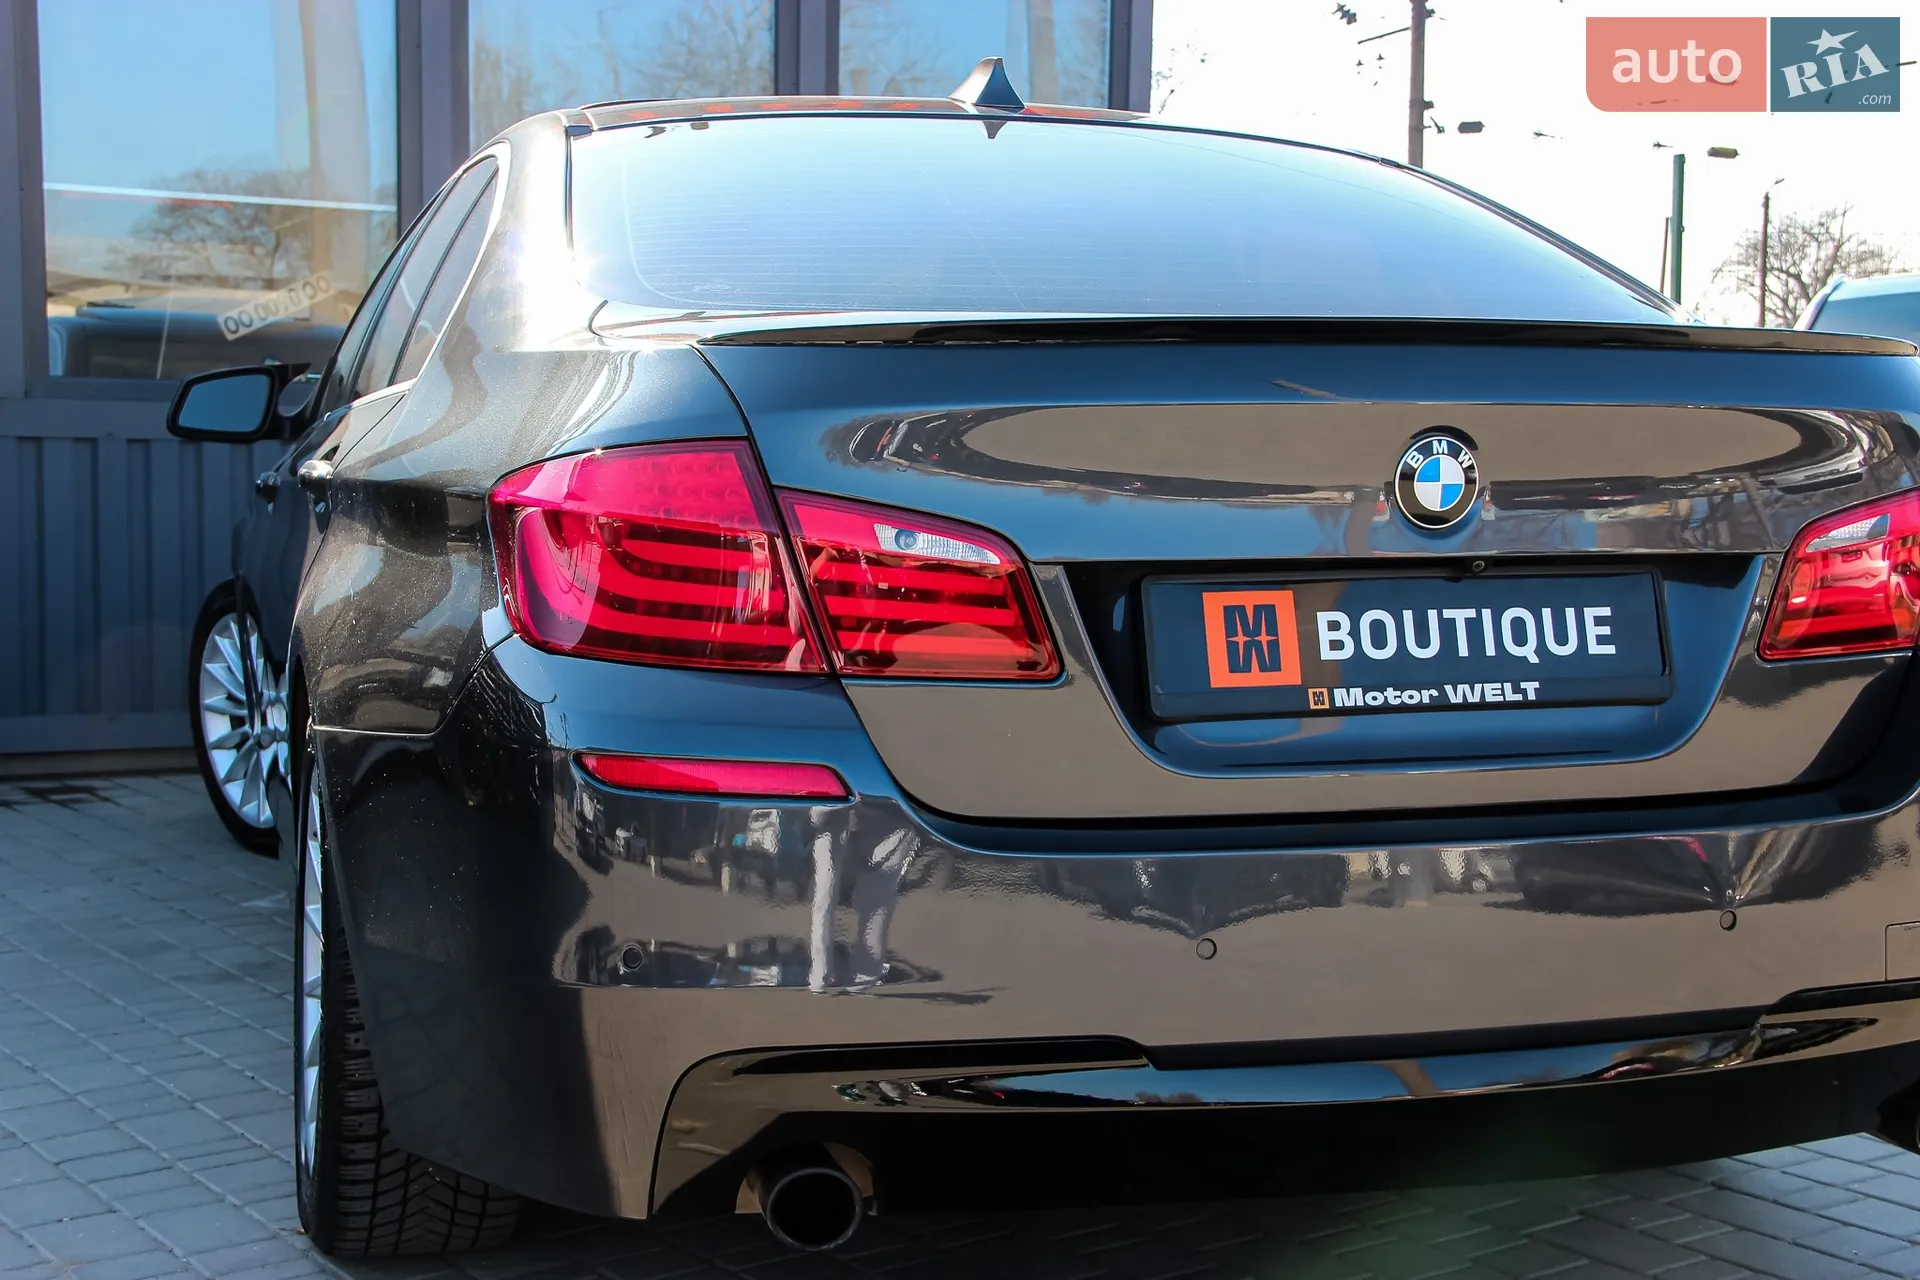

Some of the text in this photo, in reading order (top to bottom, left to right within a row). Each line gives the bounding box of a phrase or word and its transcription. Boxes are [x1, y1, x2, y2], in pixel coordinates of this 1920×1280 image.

[1406, 440, 1473, 469] BMW
[1316, 606, 1617, 664] BOUTIQUE
[1333, 681, 1540, 707] Motor WELT
